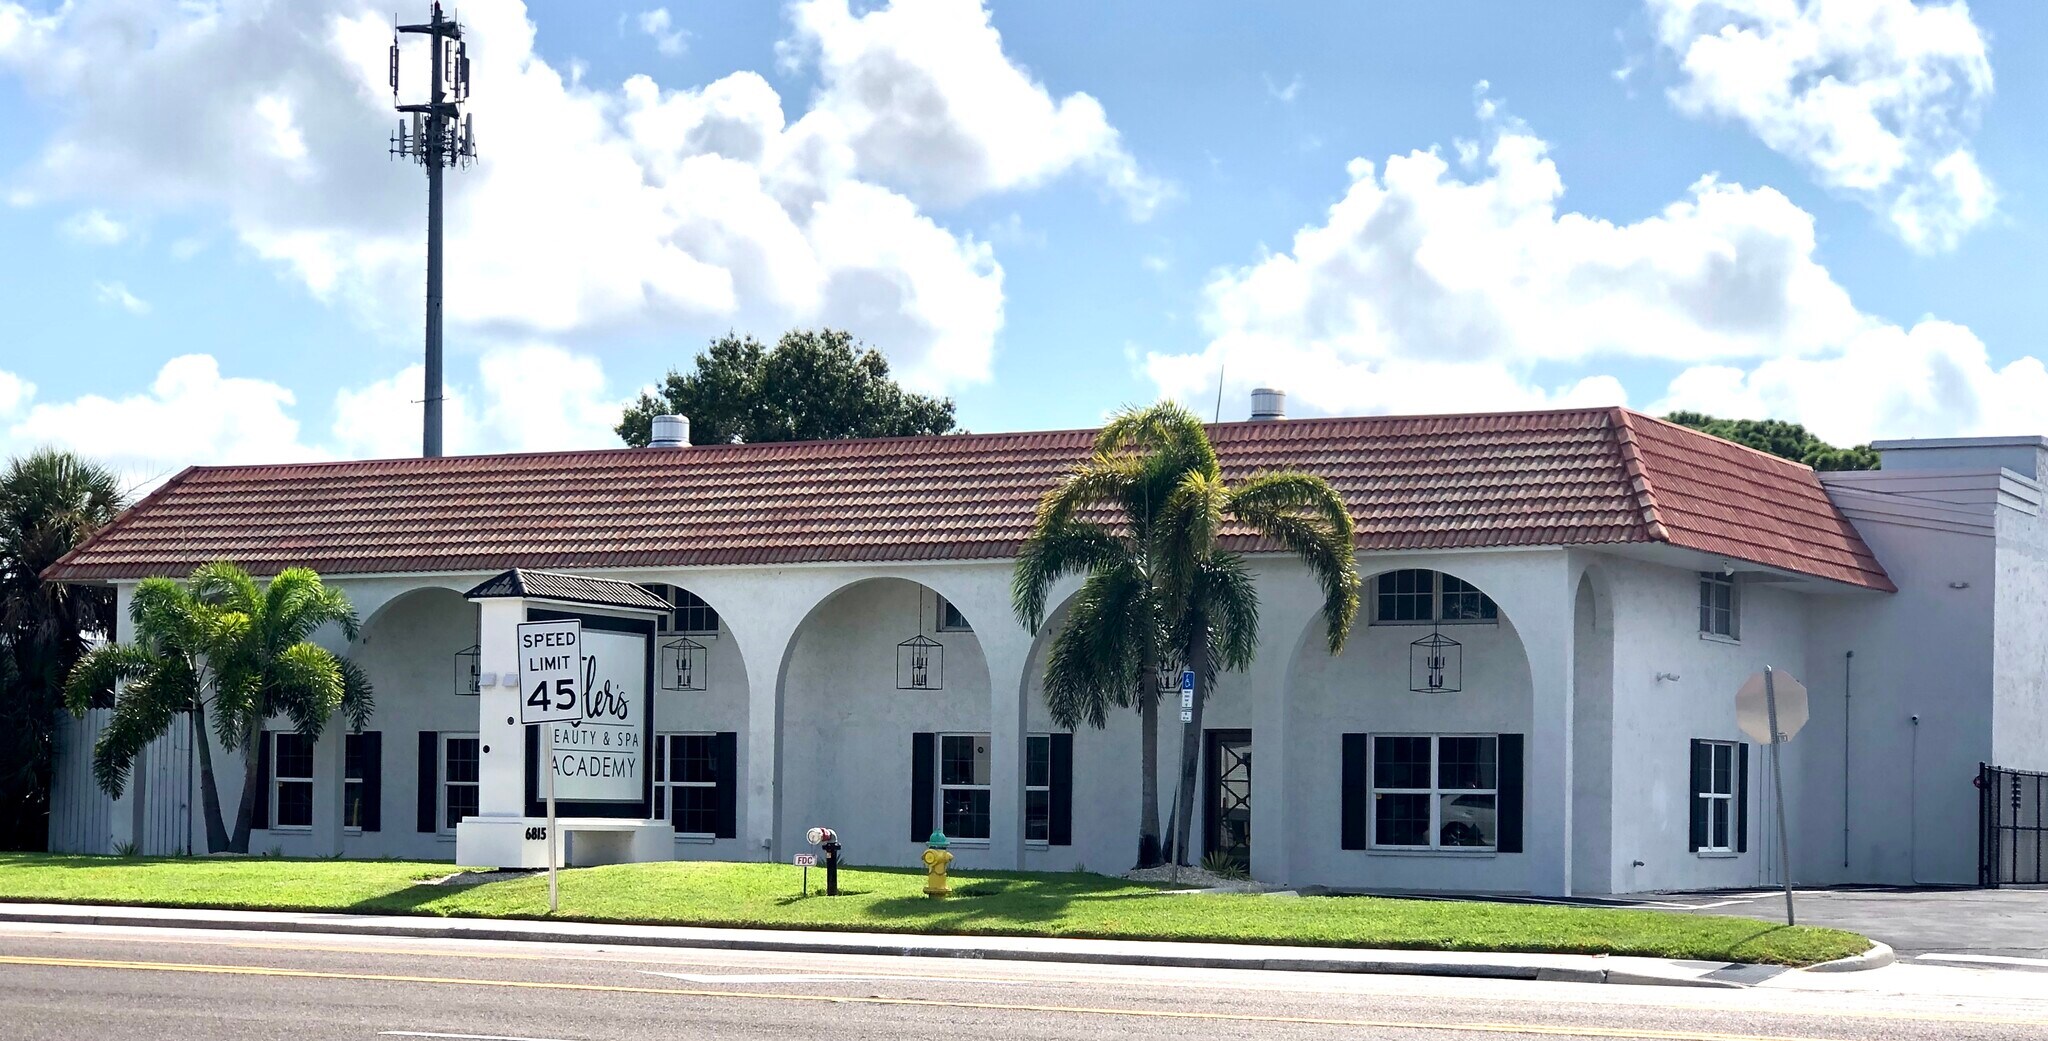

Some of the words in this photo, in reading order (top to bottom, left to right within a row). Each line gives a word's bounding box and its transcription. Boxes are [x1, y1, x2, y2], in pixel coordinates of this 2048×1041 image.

[523, 632, 576, 648] SPEED
[529, 655, 571, 672] LIMIT
[527, 678, 577, 712] 45
[582, 655, 630, 720] ler's
[554, 729, 597, 745] EAUTY
[603, 731, 611, 746] &
[617, 732, 639, 747] SPA
[552, 755, 636, 778] ACADEMY
[525, 826, 547, 841] 6815
[797, 856, 813, 865] FDC
